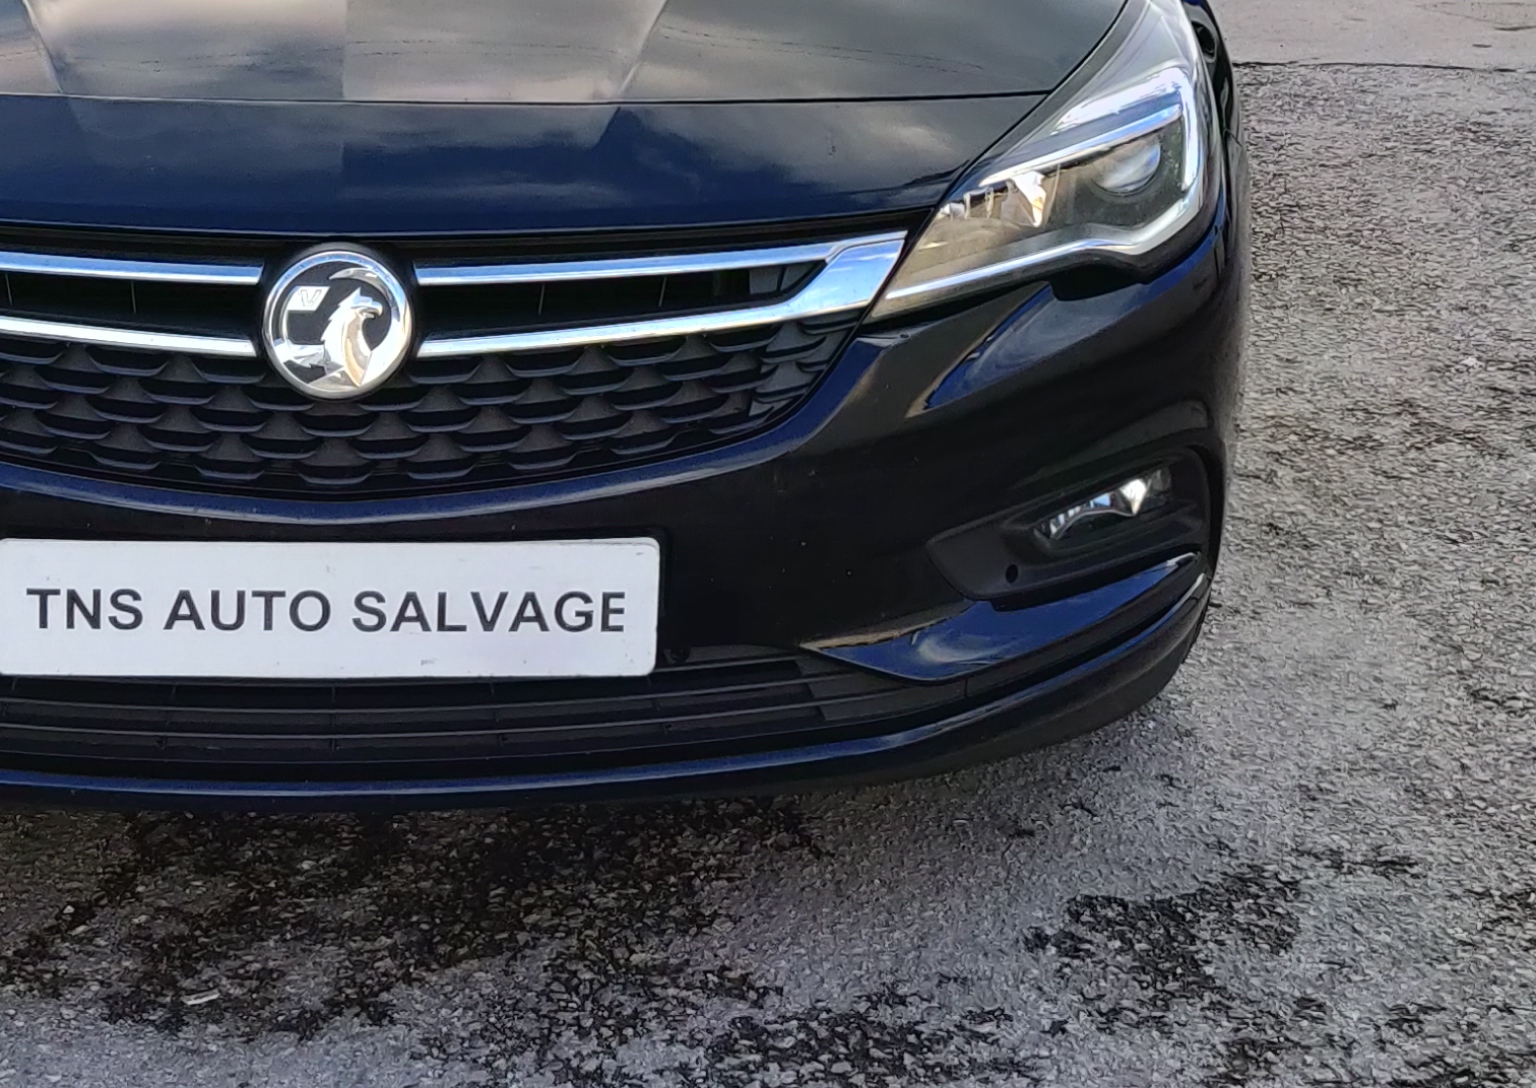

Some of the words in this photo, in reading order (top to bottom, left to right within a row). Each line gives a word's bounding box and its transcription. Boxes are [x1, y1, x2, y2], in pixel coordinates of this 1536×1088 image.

[27, 588, 143, 630] TNS
[163, 589, 332, 632] AUTO
[352, 591, 625, 633] SALVAGE
